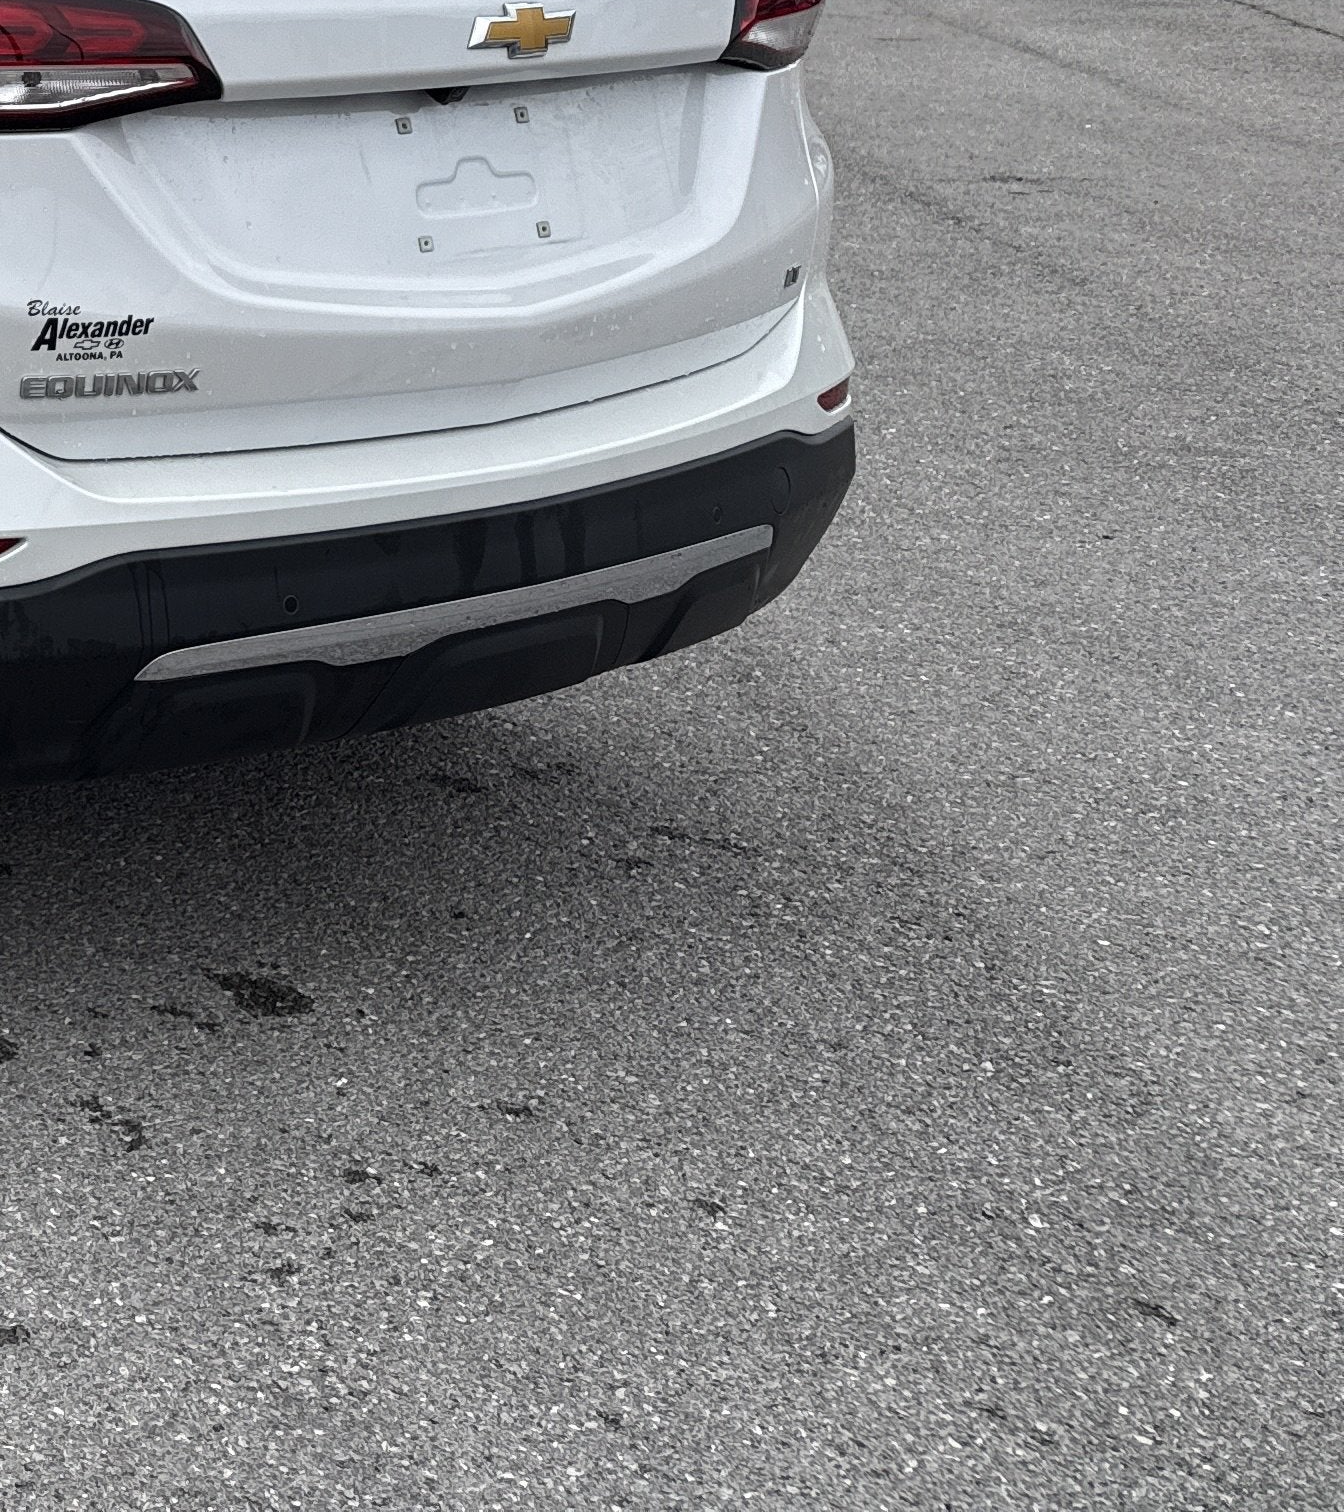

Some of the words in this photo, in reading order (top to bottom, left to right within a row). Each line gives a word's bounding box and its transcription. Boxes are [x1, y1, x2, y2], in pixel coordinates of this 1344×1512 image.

[26, 298, 82, 317] Blaise
[30, 314, 155, 352] Alexander
[55, 352, 108, 362] ALTOONA,
[109, 350, 124, 360] PA
[19, 367, 201, 400] EQUINOX
